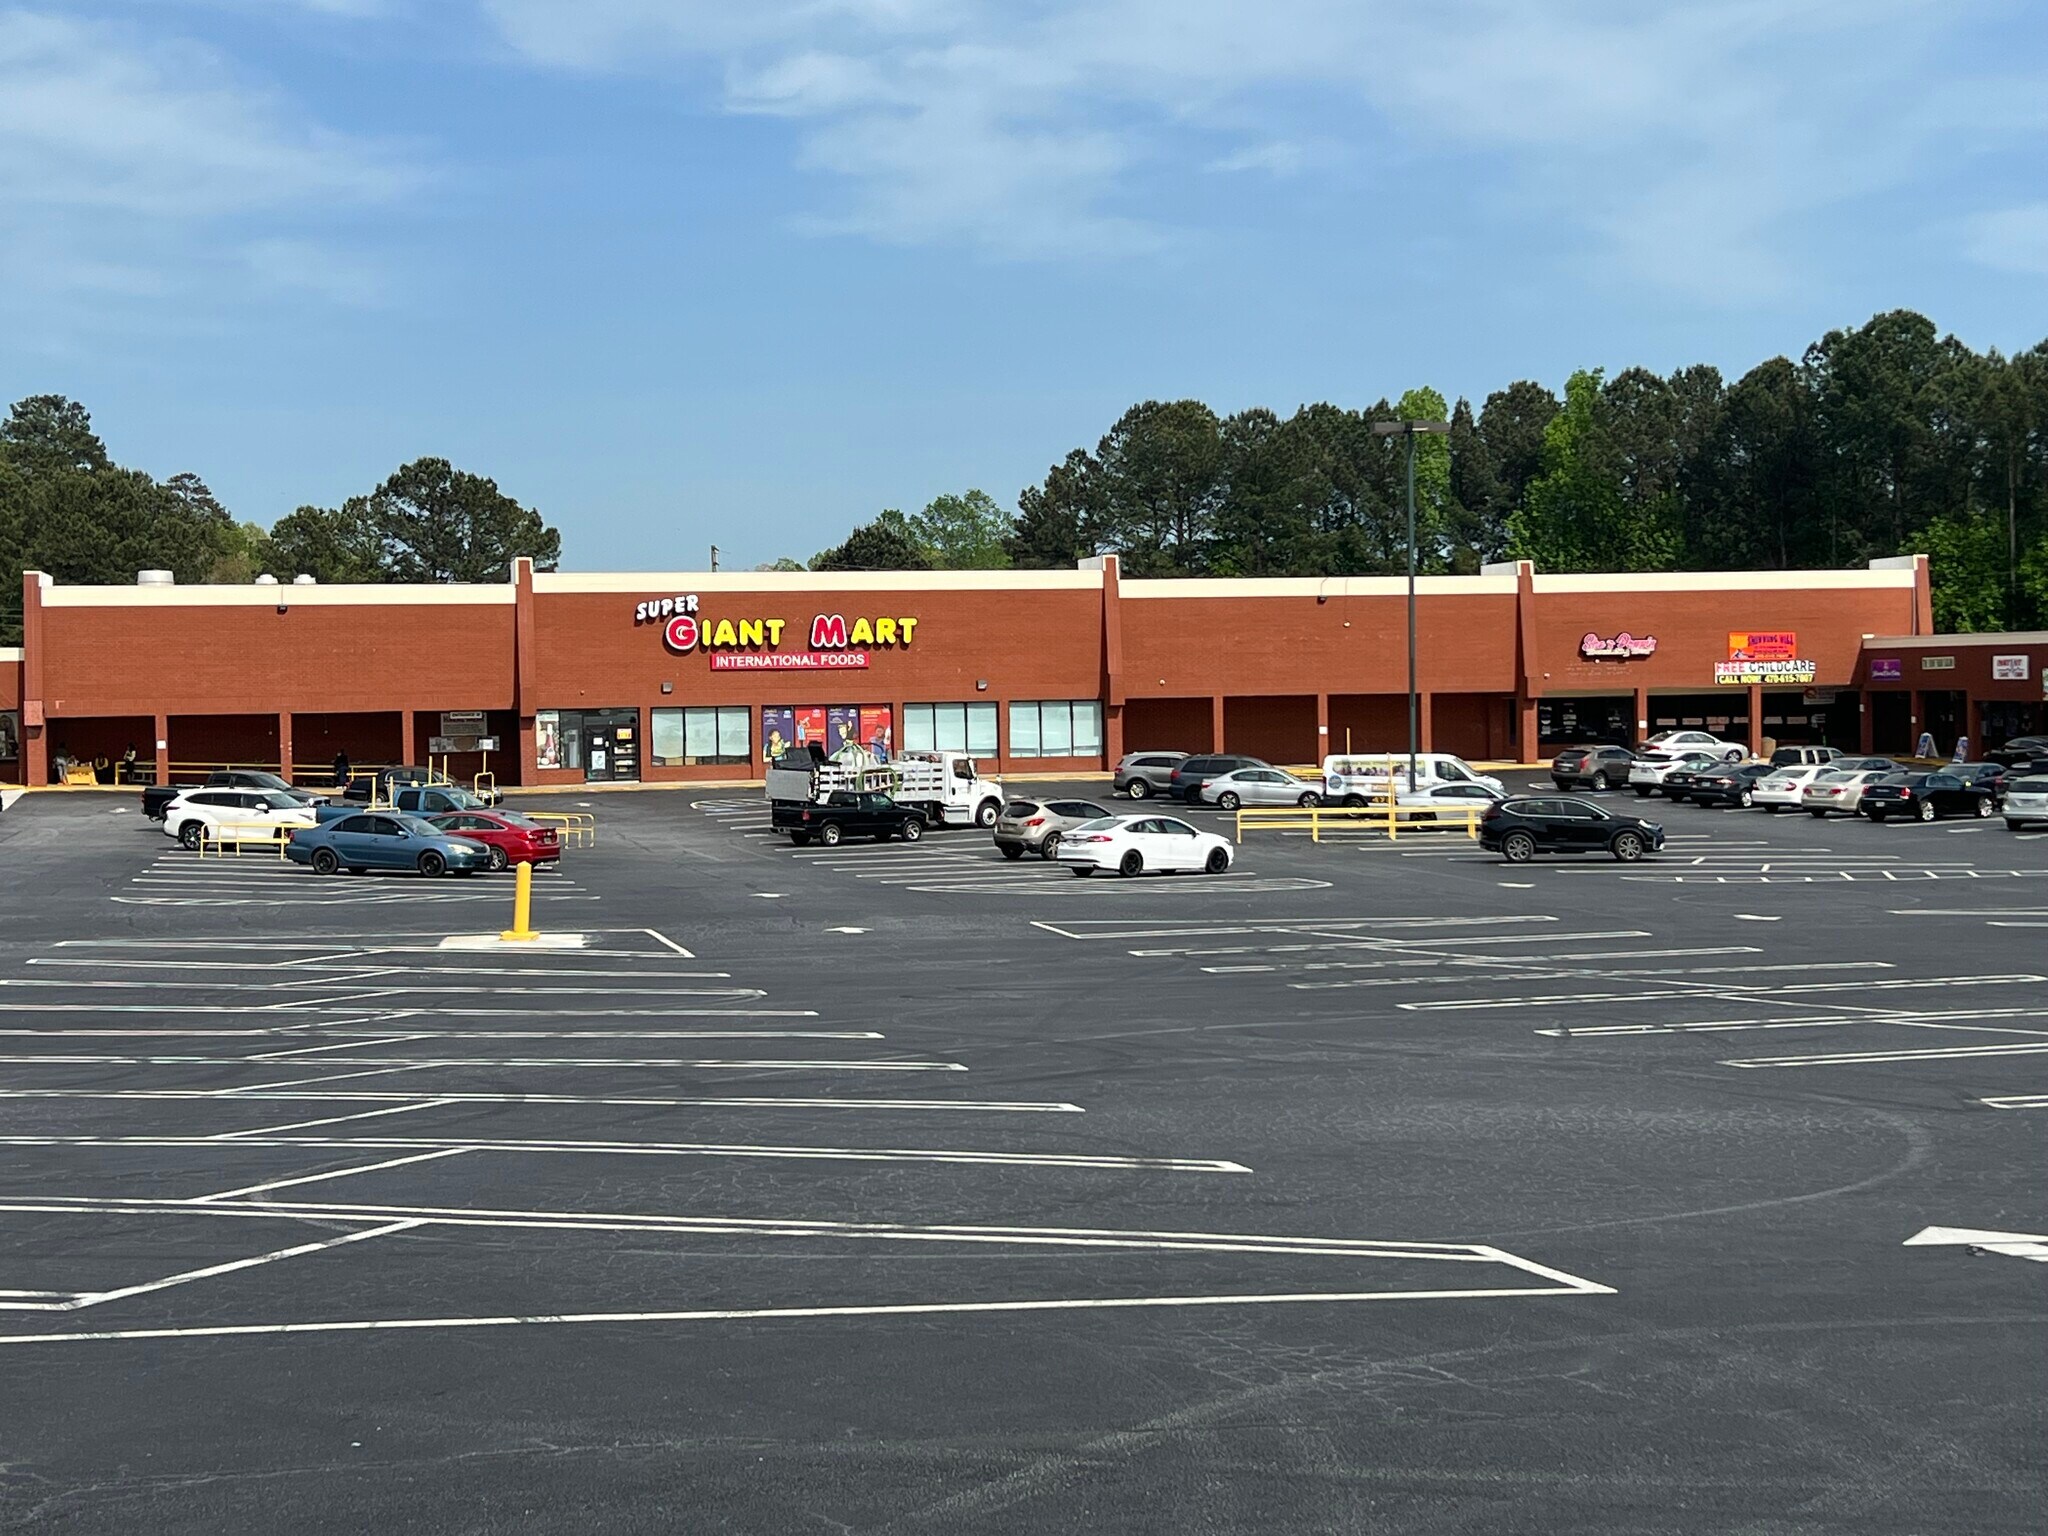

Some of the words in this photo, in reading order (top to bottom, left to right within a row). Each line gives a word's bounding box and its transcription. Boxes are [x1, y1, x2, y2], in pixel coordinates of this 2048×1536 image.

[635, 594, 699, 620] SUPER
[665, 614, 786, 650] GIANT
[811, 613, 919, 648] MART
[715, 655, 818, 668] INTERNATIONAL
[820, 653, 866, 667] FOODS
[1716, 661, 1745, 672] FREE
[1748, 660, 1815, 672] CHILDCARE
[1718, 674, 1740, 684] CALL
